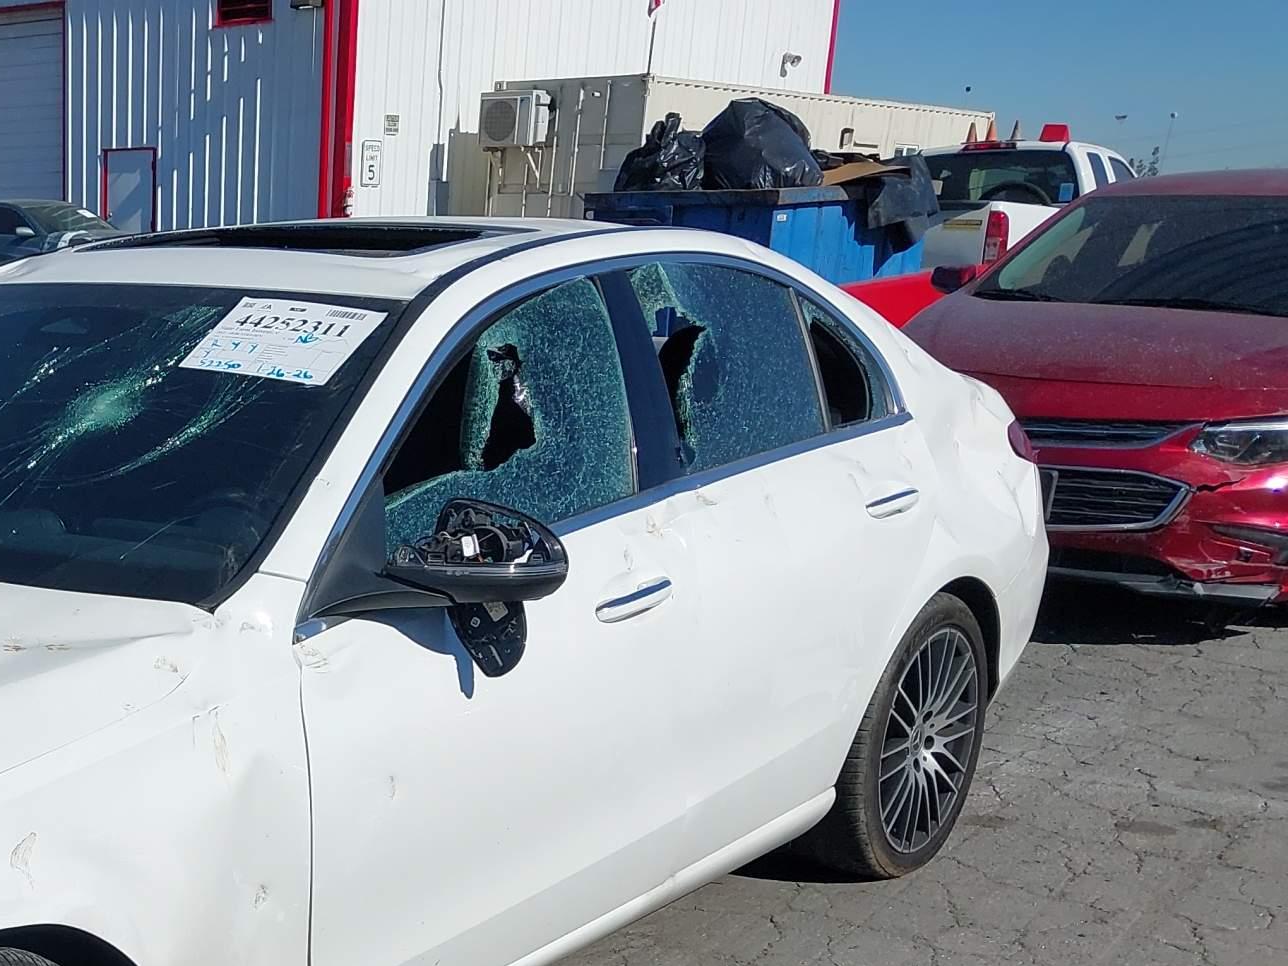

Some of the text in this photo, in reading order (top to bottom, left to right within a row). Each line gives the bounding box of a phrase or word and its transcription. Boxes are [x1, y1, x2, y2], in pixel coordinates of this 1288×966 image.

[365, 144, 380, 152] SPEED
[368, 164, 375, 180] 5
[235, 313, 351, 337] 44252311
